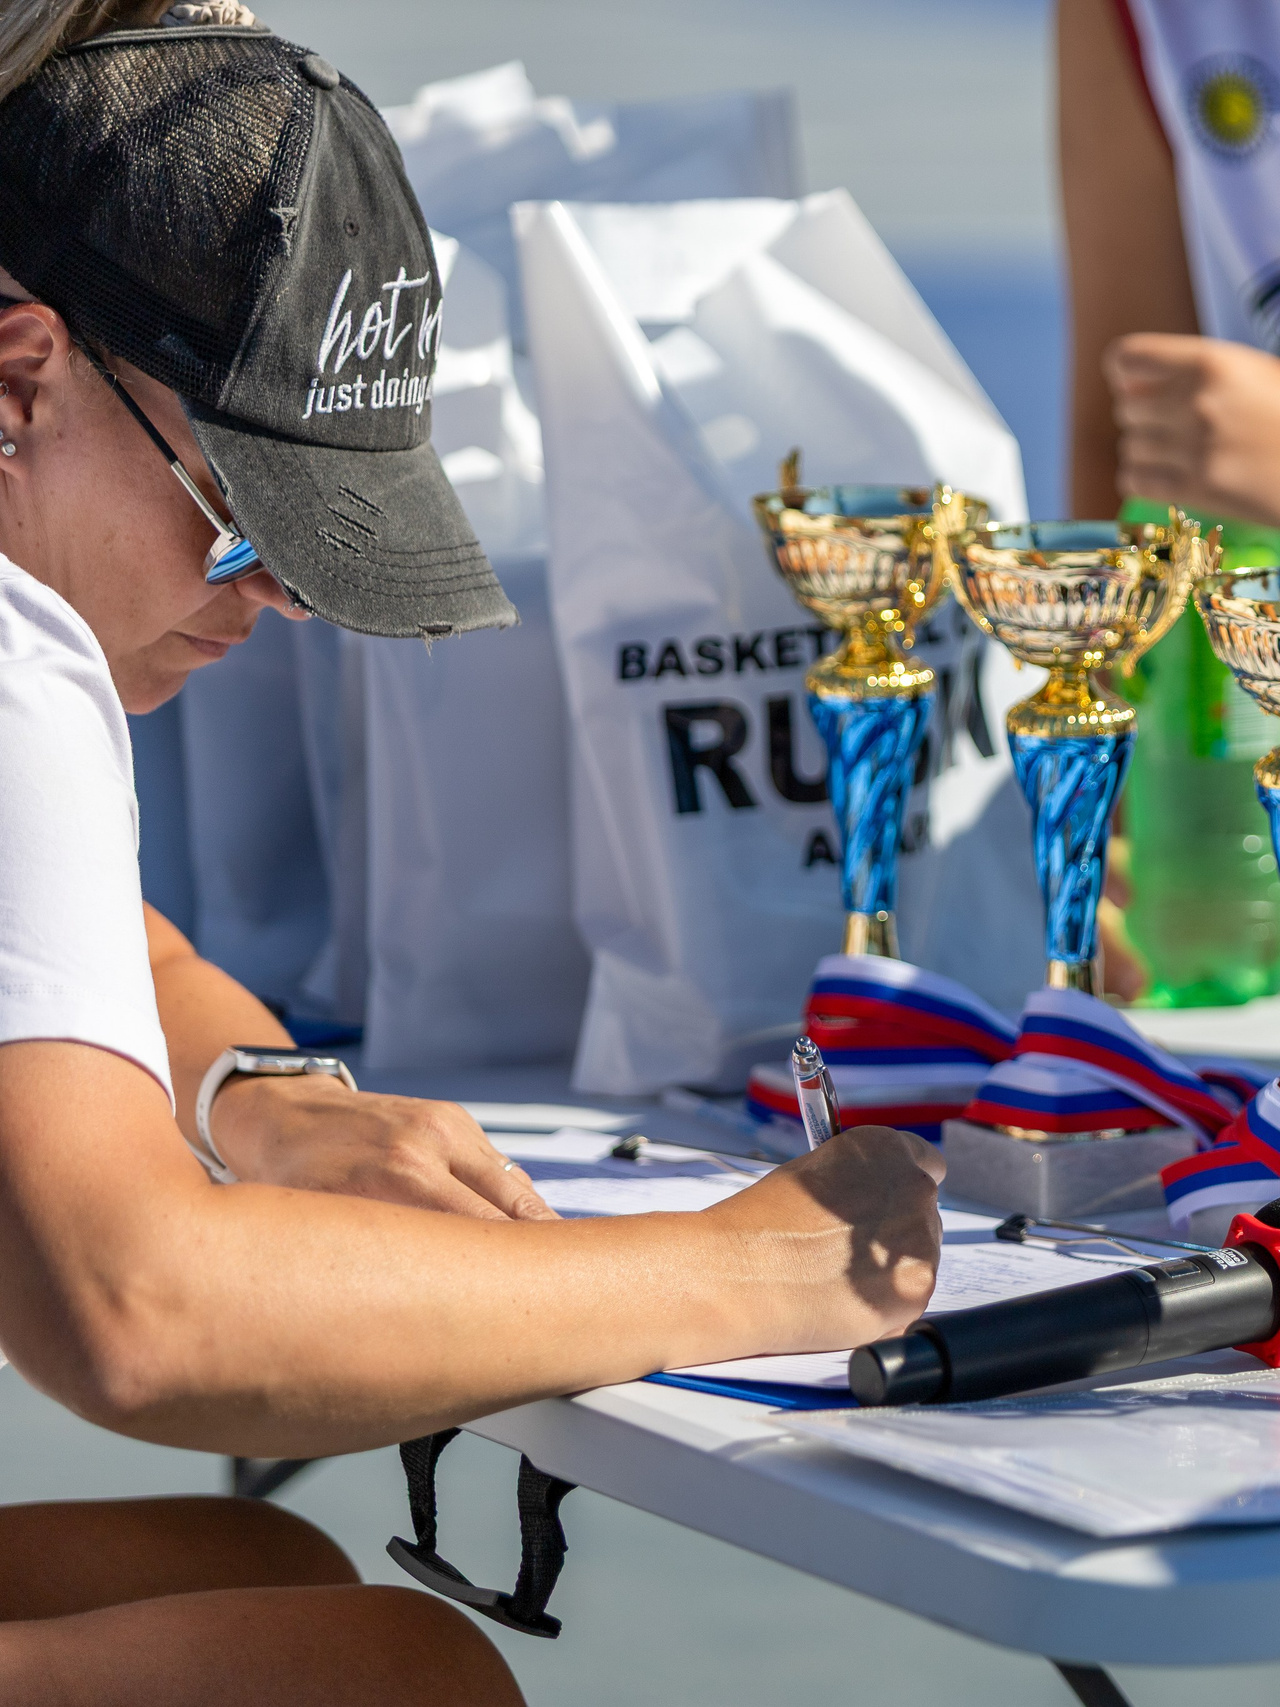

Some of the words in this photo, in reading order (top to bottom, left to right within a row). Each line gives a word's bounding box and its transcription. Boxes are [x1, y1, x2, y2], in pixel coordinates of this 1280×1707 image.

[317, 266, 430, 374] hot
[302, 374, 367, 420] just
[370, 367, 428, 415] doing
